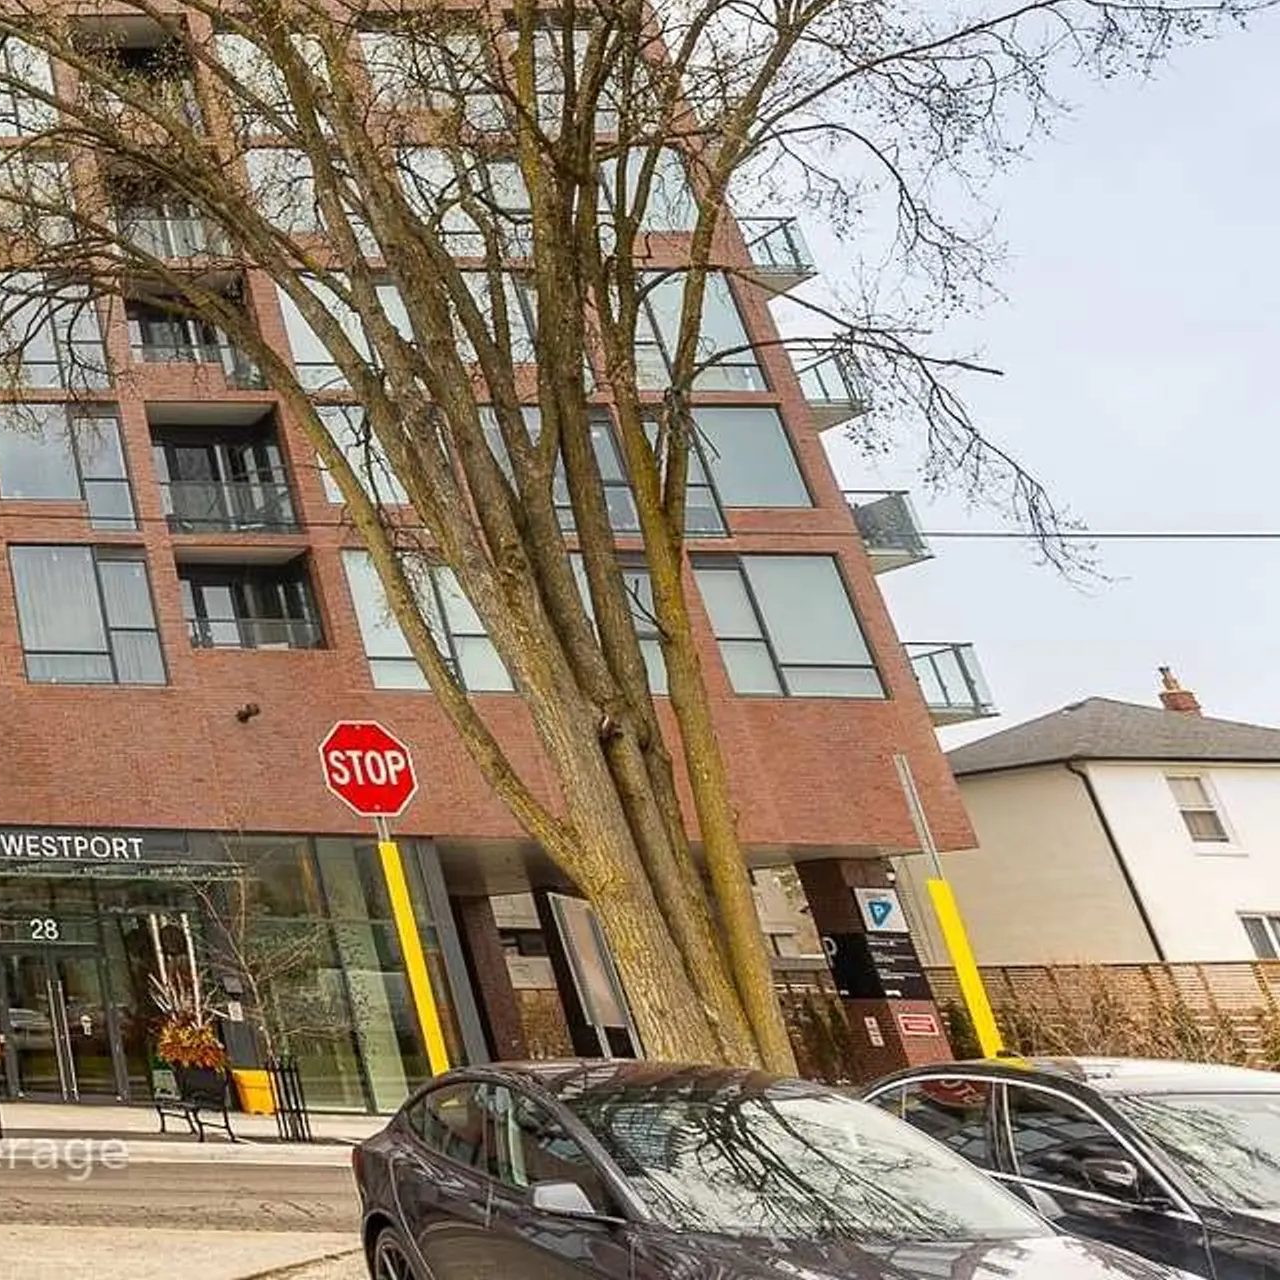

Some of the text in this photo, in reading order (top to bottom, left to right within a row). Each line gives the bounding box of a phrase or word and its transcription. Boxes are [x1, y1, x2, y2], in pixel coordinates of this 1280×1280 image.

[328, 749, 406, 786] STOP
[0, 834, 144, 859] WESTPORT
[29, 918, 60, 941] 28
